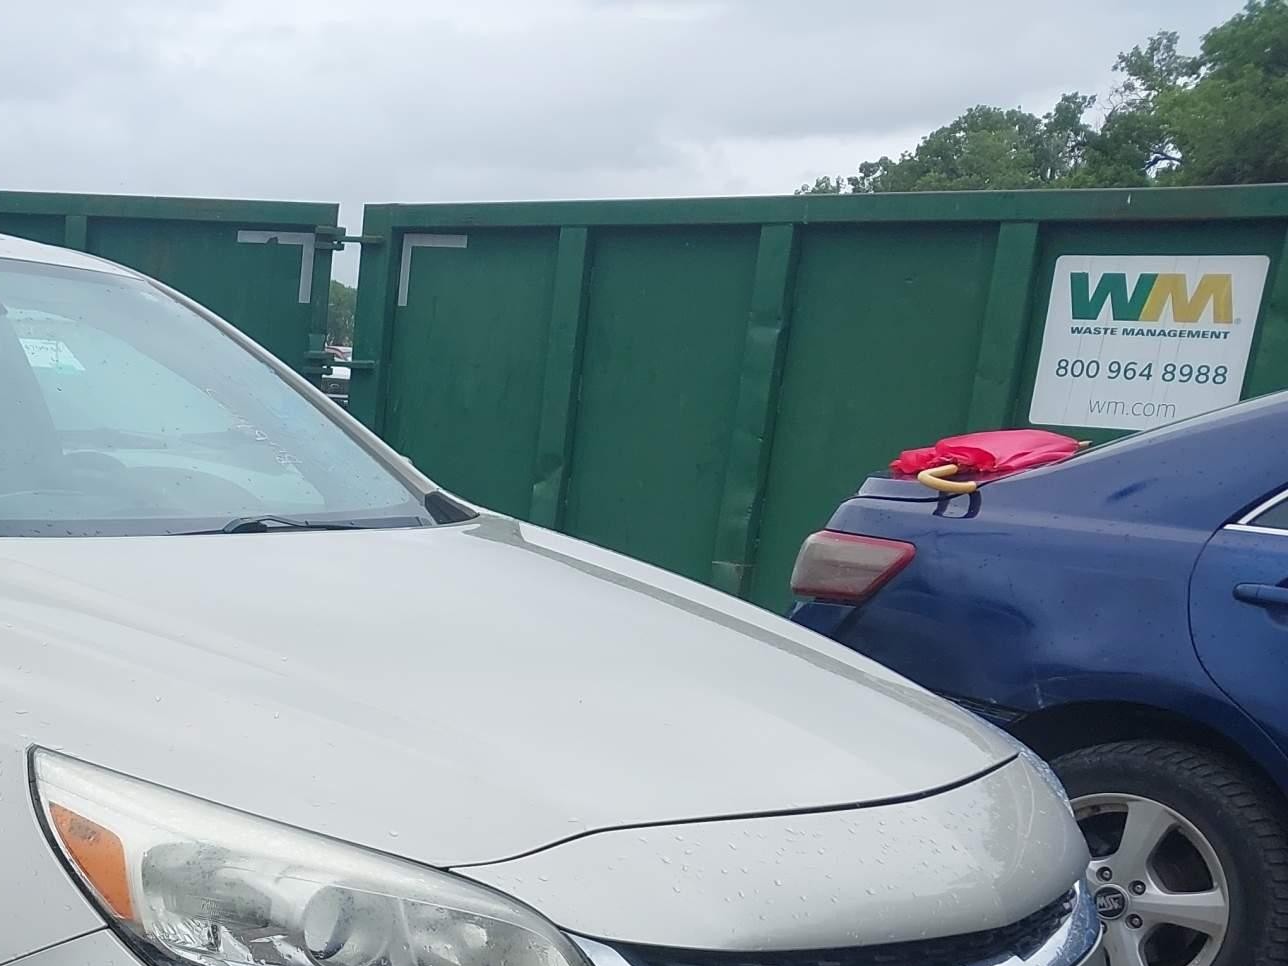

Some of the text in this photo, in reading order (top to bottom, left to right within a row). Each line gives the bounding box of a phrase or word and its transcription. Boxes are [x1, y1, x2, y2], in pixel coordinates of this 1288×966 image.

[1070, 271, 1234, 324] WM
[1070, 326, 1231, 341] WASTE MANAGEMENT
[1055, 358, 1229, 386] 800 964 8988
[1088, 399, 1177, 419] wm.com
